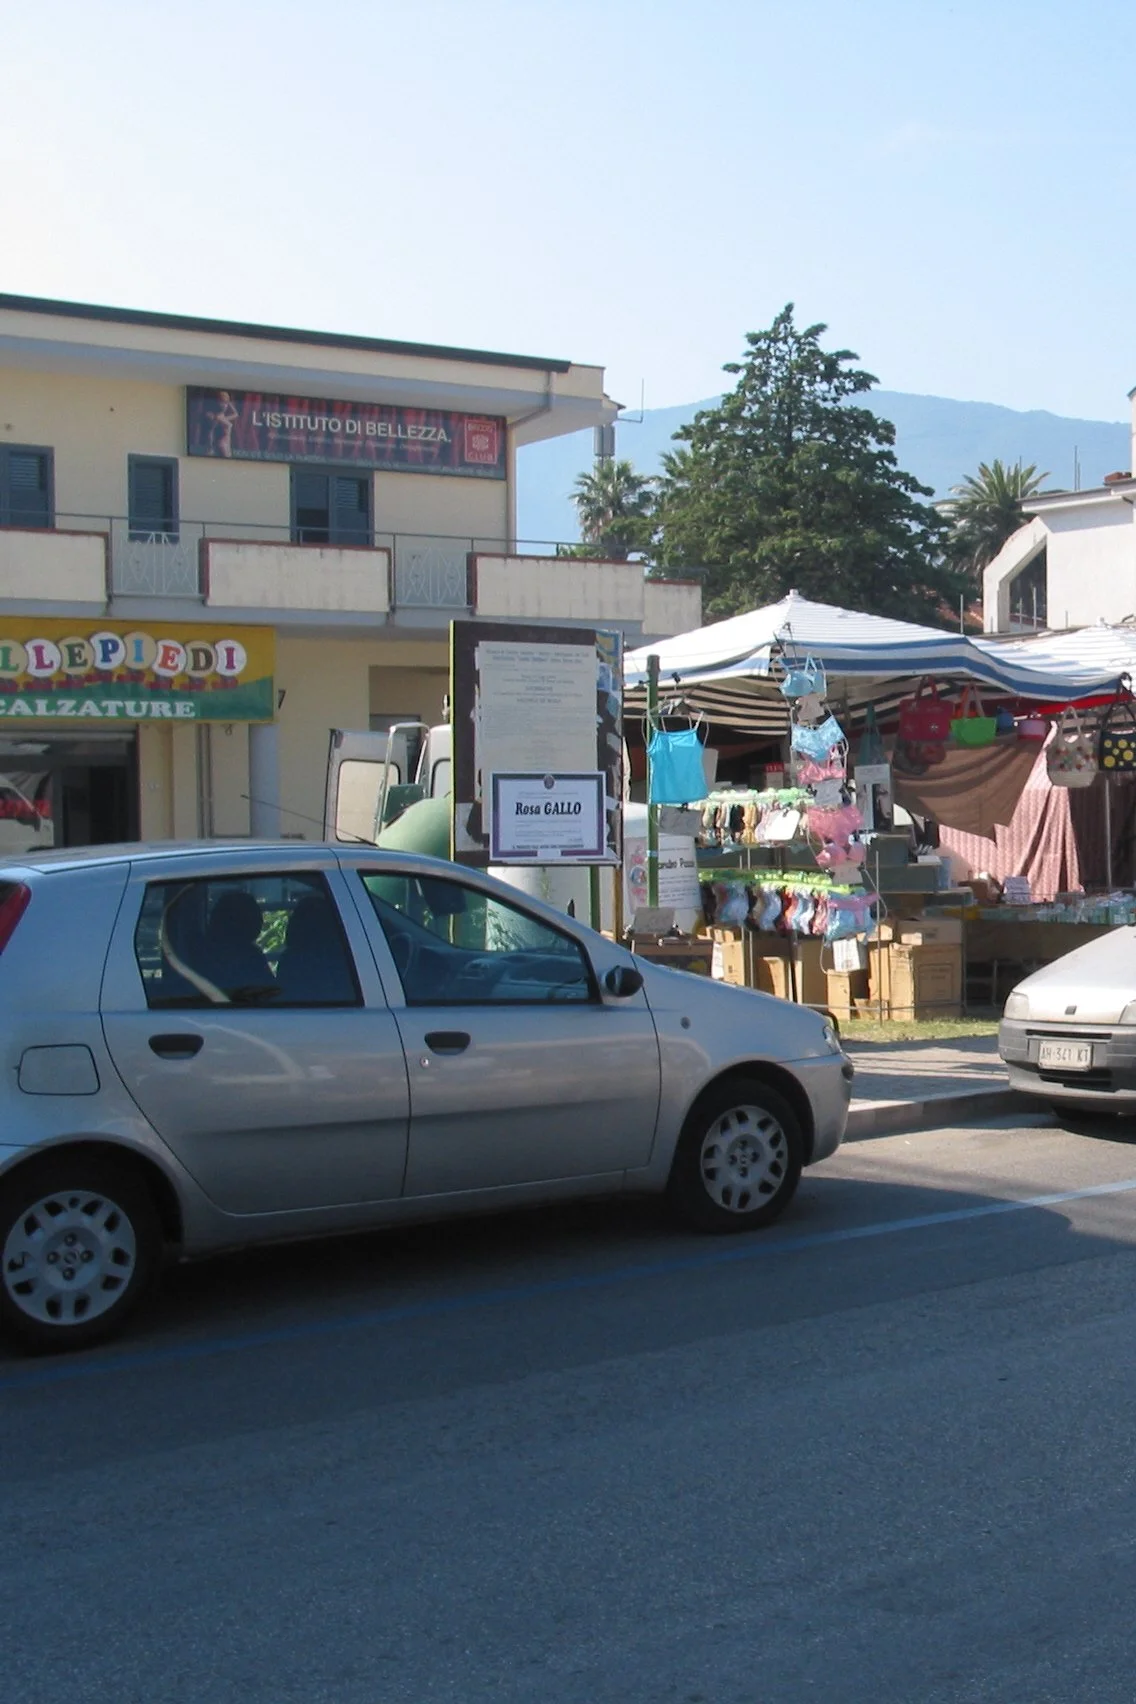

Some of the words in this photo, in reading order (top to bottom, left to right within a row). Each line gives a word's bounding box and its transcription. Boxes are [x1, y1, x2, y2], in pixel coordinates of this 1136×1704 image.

[252, 411, 341, 433] L'ISTITUTO
[346, 419, 362, 435] DI
[366, 421, 452, 443] BELLEZZA.
[0, 699, 196, 718] ALZATURE
[515, 802, 540, 815] Rosa
[544, 801, 582, 815] GALLO
